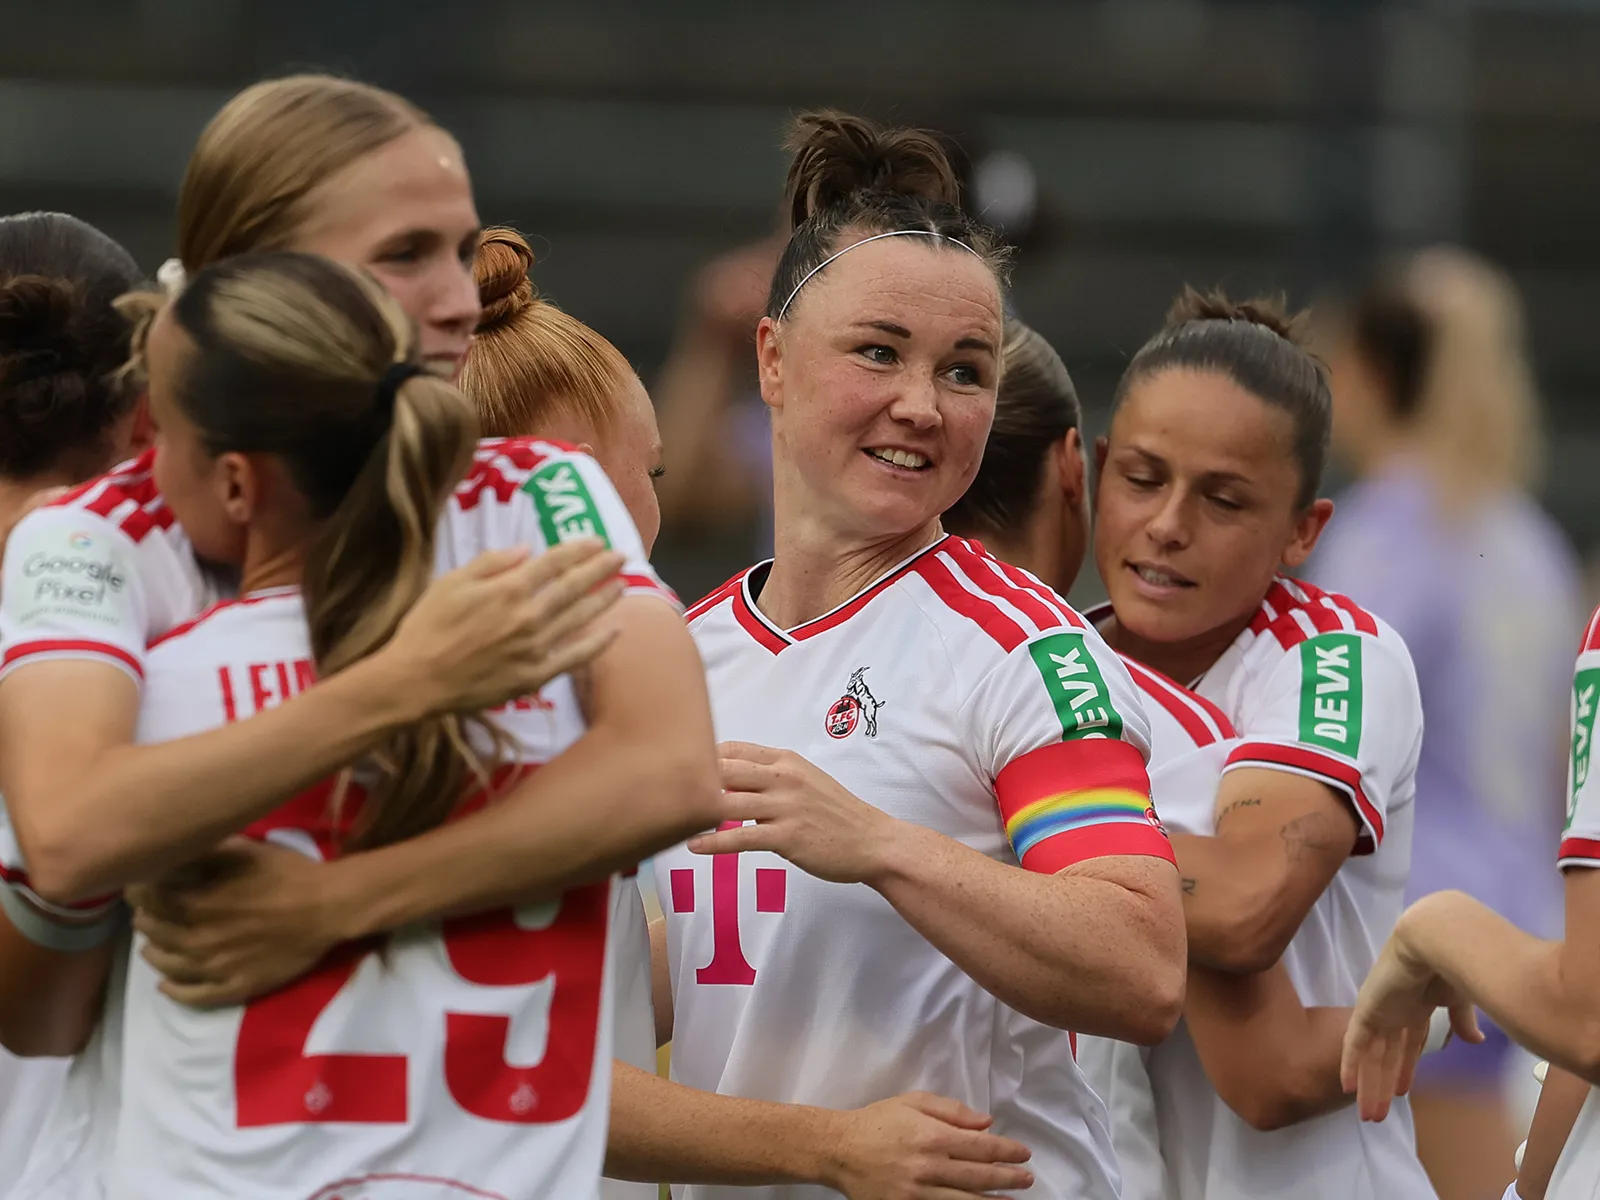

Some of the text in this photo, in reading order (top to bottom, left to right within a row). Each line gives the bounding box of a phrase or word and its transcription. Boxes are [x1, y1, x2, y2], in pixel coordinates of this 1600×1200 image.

[535, 466, 596, 543] EVK
[22, 551, 125, 593] Google
[34, 578, 105, 605] Pixel
[1048, 647, 1109, 739] EVK
[1314, 644, 1350, 743] DEVK
[235, 763, 611, 1129] 29
